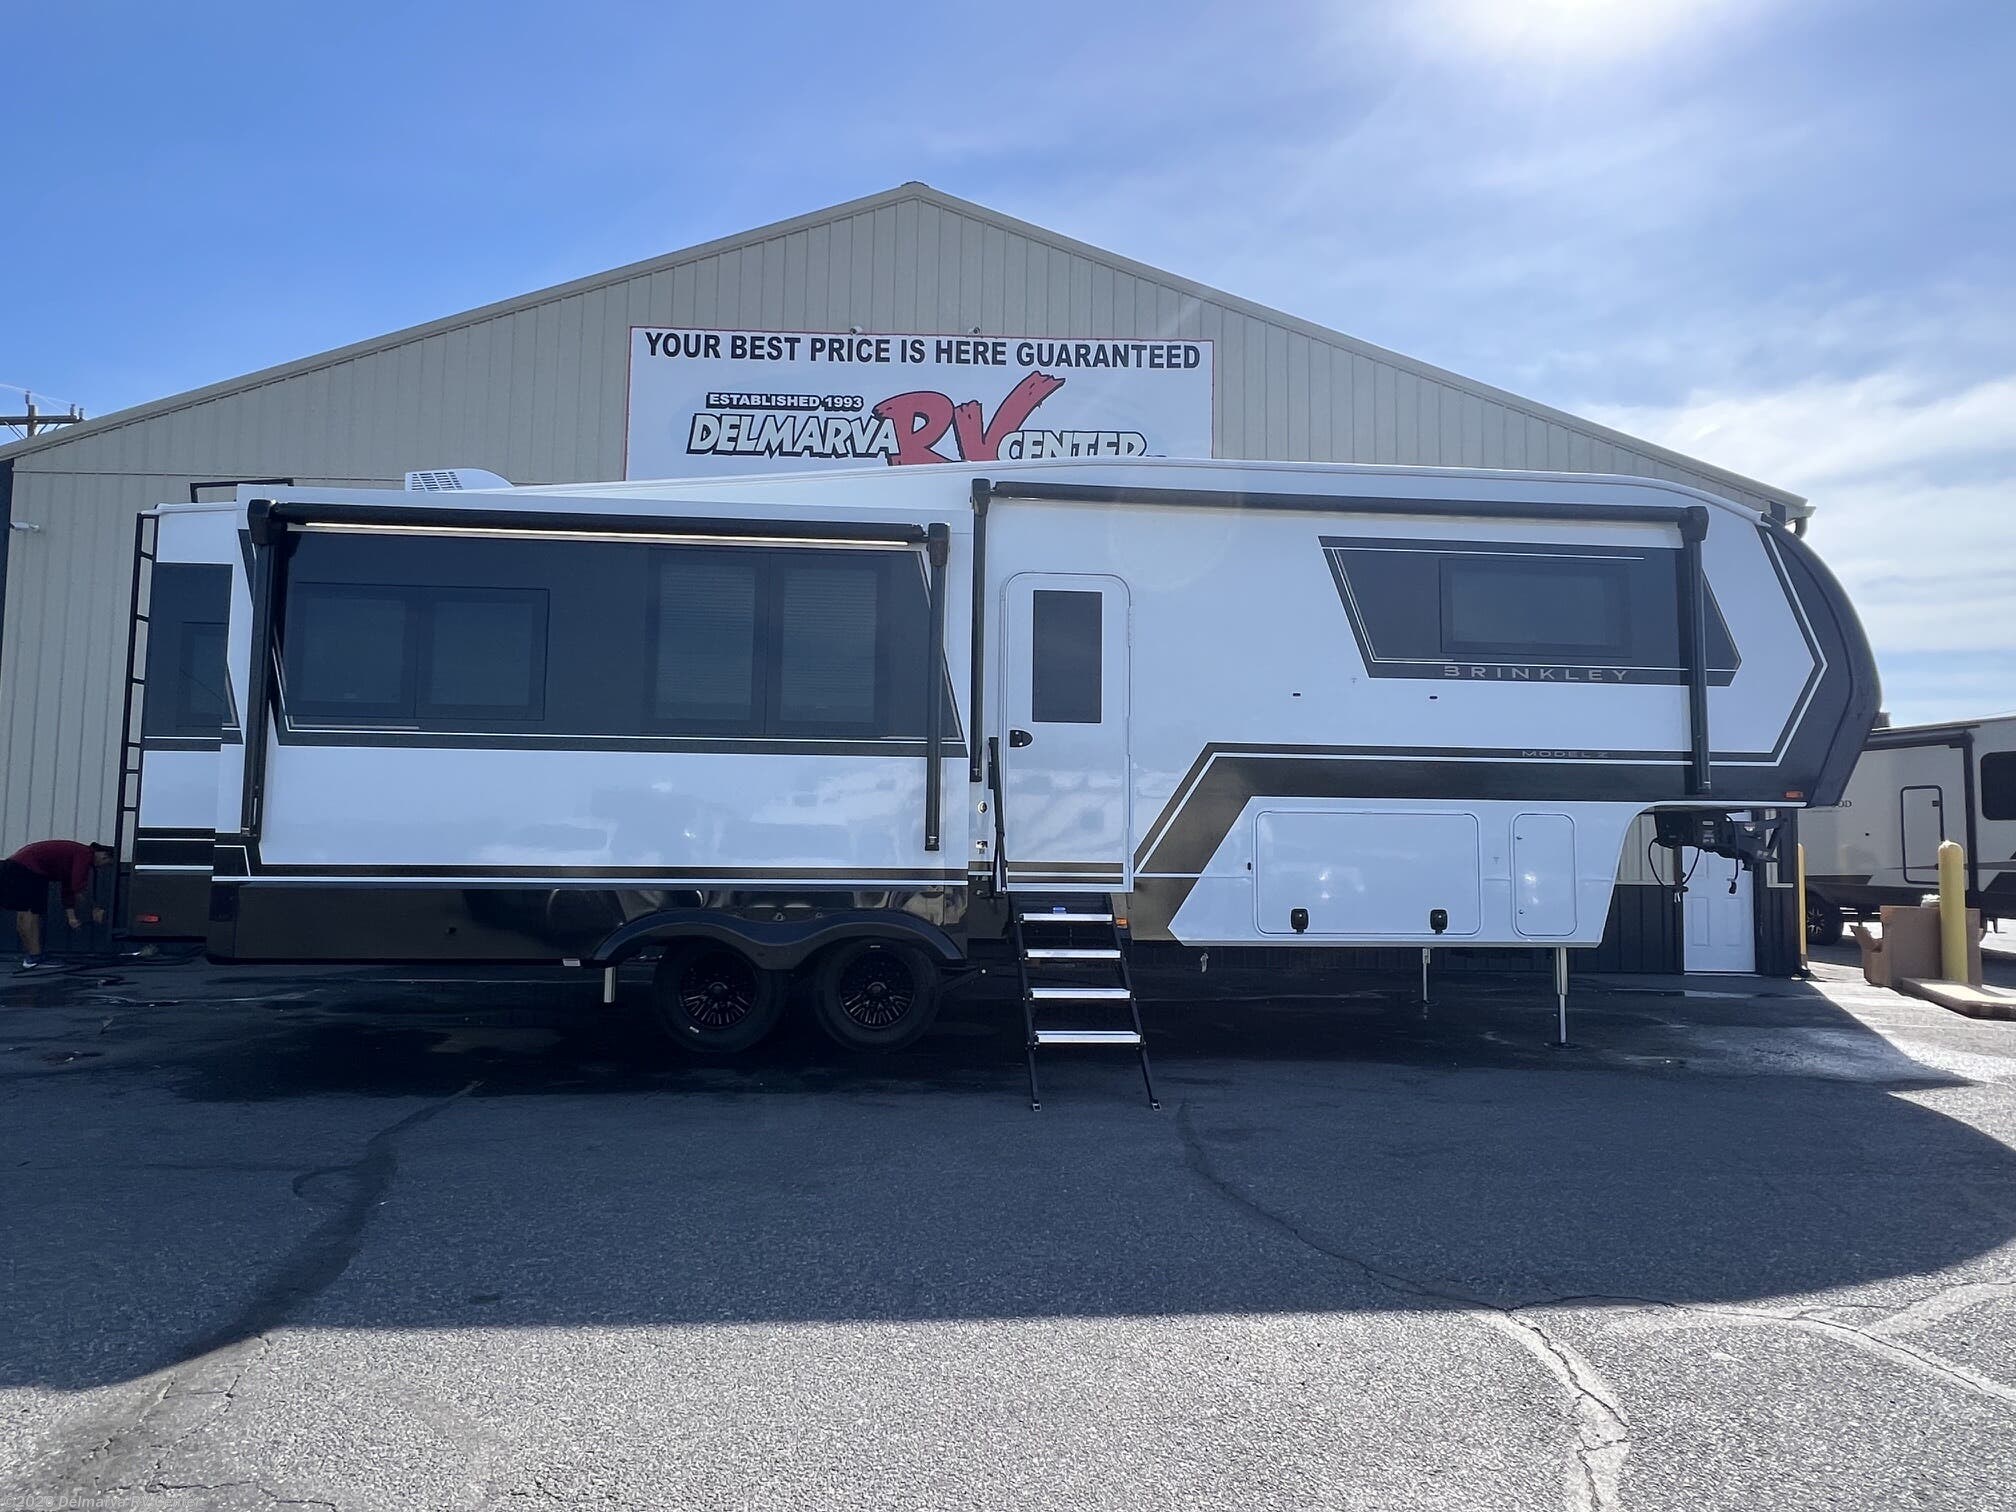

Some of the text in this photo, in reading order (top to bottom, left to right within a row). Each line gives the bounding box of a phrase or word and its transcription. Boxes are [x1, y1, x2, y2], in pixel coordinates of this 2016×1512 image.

[645, 331, 1201, 369] YOUR BEST PRICE IS HERE GUARANTEED
[707, 392, 864, 411] ESTABLISHED 1993
[686, 370, 1148, 466] DELMARVA RV CENTER
[1444, 664, 1629, 681] BRINKLEY
[1521, 750, 1592, 759] MODEL
